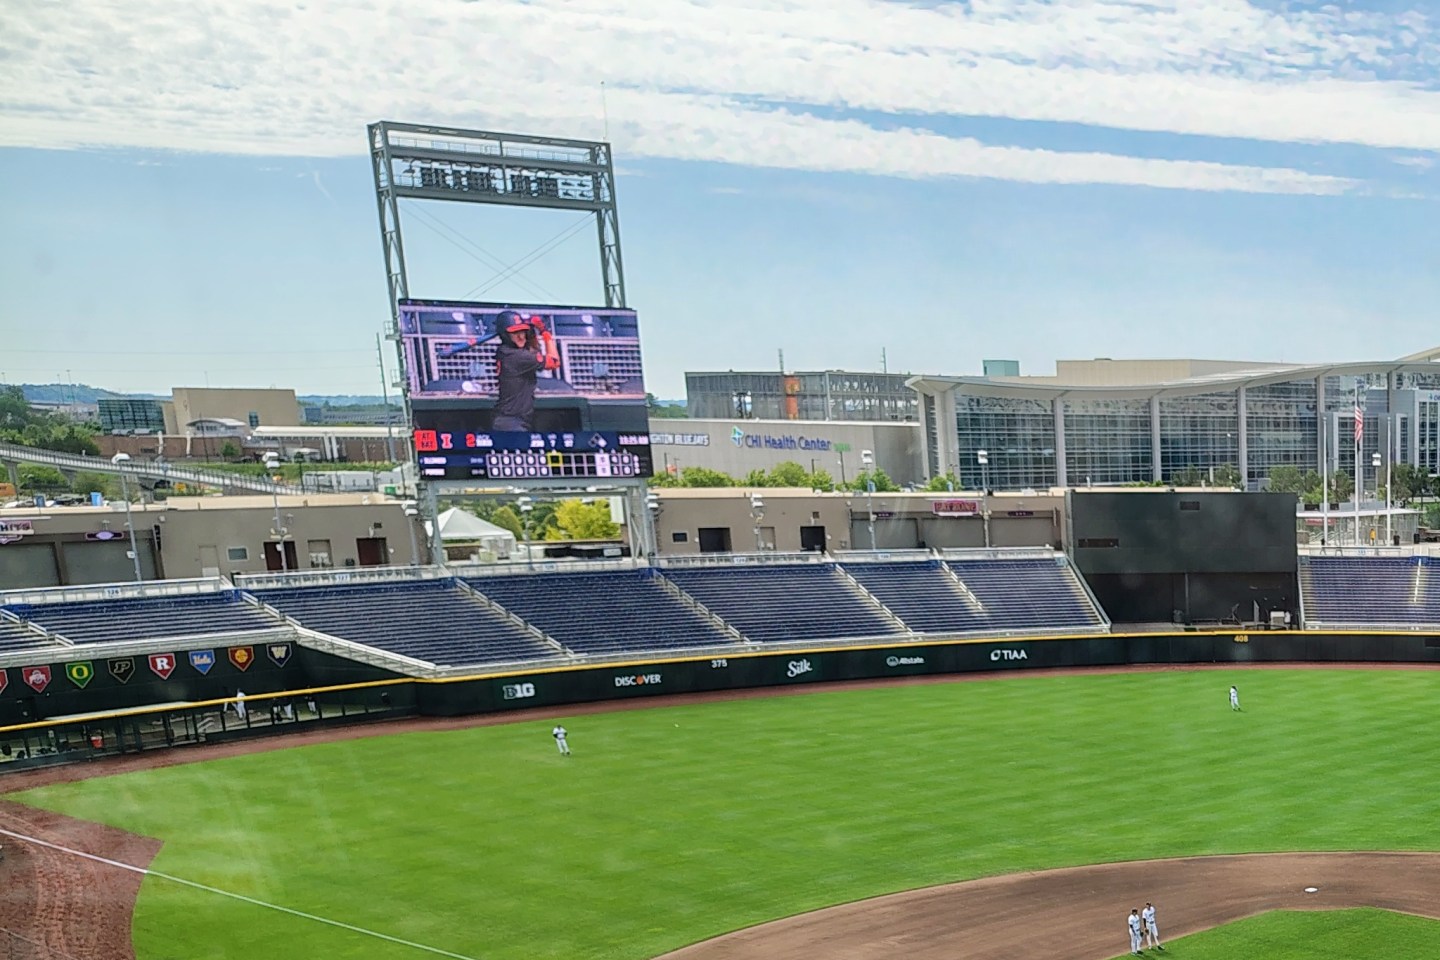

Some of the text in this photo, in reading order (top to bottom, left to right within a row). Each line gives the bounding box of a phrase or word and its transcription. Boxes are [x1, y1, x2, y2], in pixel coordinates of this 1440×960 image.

[745, 435, 760, 448] CHI
[765, 436, 796, 449] Health
[800, 436, 832, 451] Center
[271, 645, 288, 659] W
[1002, 649, 1028, 660] TIAA
[155, 657, 171, 671] R
[711, 659, 728, 668] 375
[787, 658, 813, 678] Silk
[615, 674, 662, 687] DISCOVER
